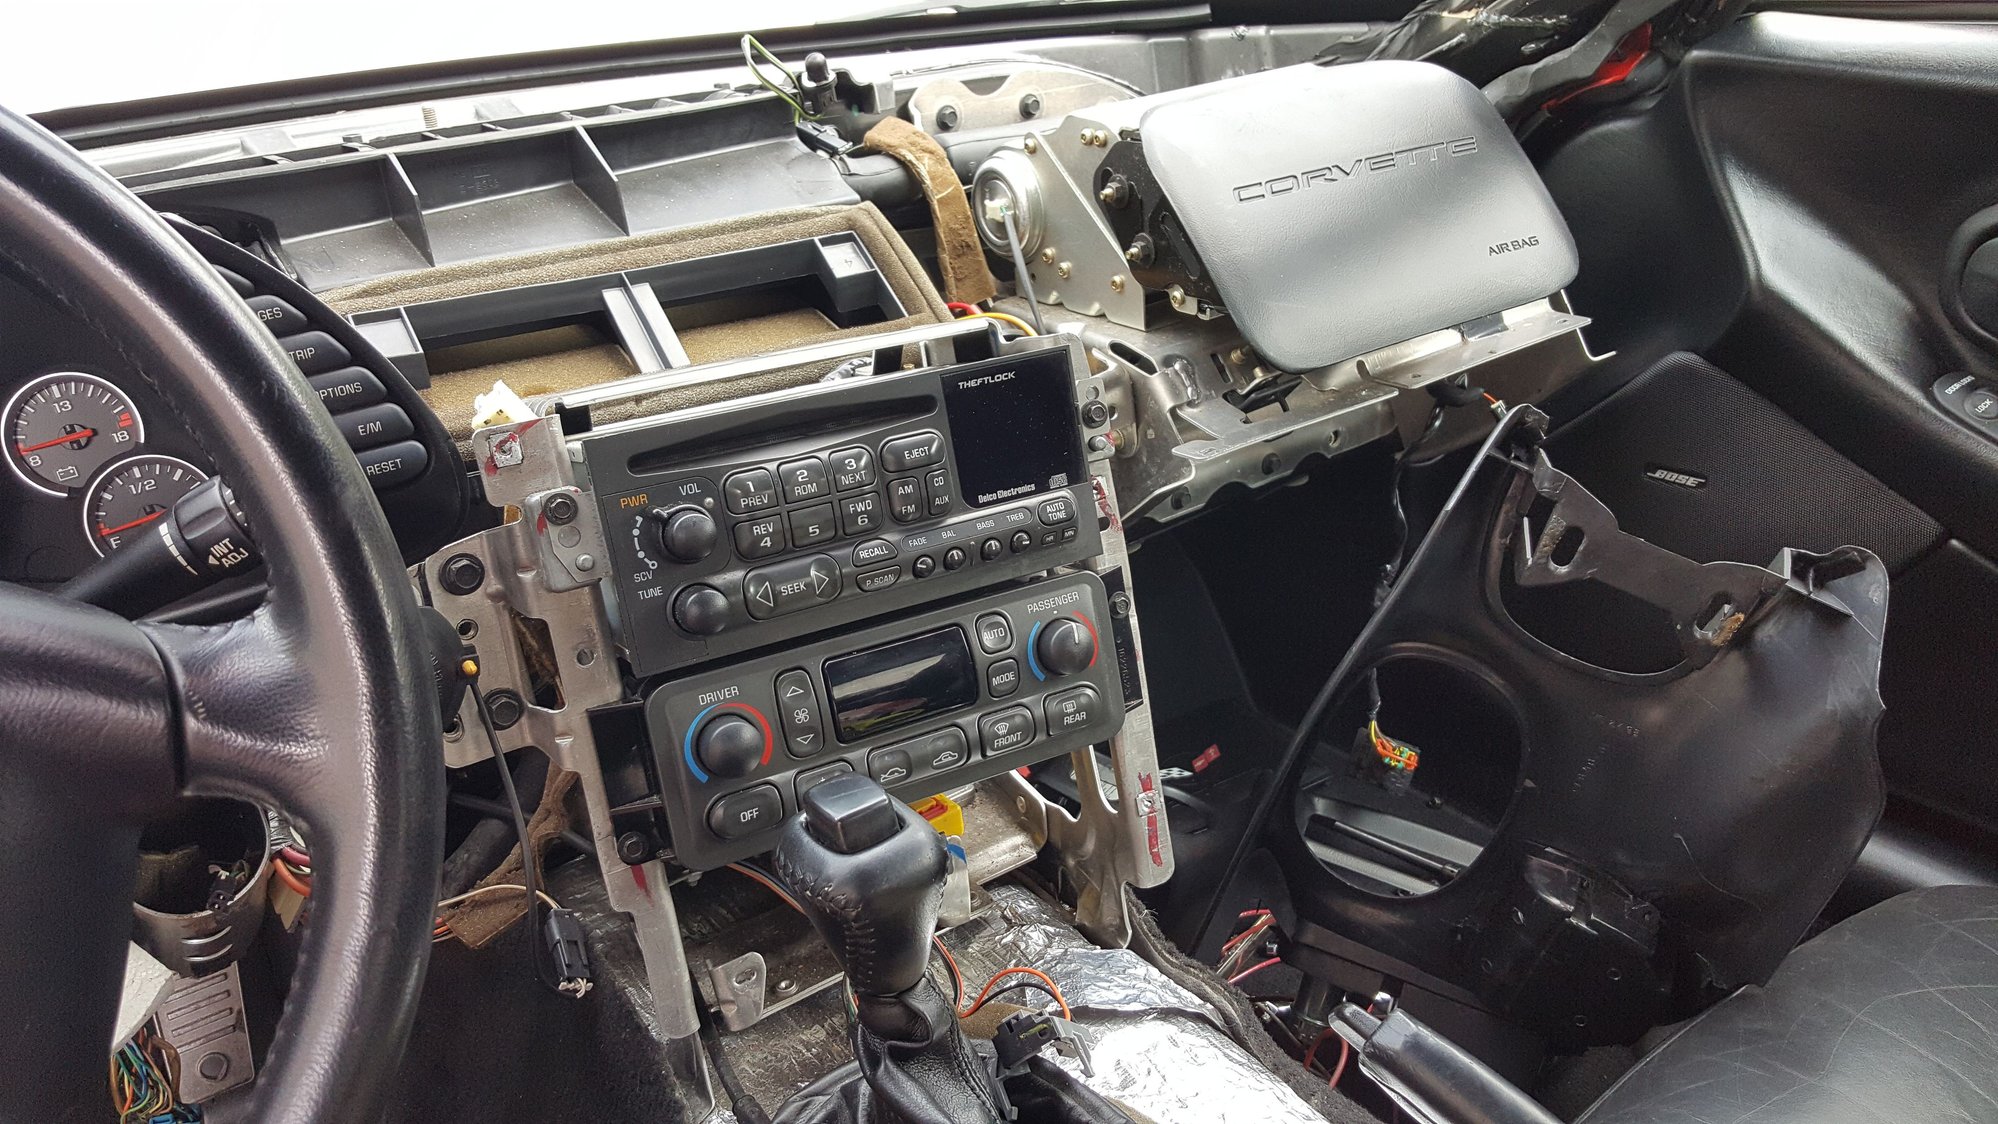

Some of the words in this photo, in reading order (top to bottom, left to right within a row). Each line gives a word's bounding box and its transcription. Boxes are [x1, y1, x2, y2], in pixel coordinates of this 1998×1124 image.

[1233, 136, 1478, 204] CORVETTE
[1488, 242, 1511, 257] AIR
[1512, 235, 1540, 251] BAG
[288, 347, 315, 361] TRIP
[958, 370, 1016, 390] THEFTLOCK
[53, 400, 72, 413] 13
[1975, 398, 1994, 413] LOCK
[358, 421, 382, 436] E/M
[111, 430, 130, 443] 18
[904, 446, 930, 460] EJECT
[29, 455, 42, 467] 8
[366, 458, 402, 476] RESET
[844, 458, 857, 470] 3
[796, 469, 808, 482] 2
[841, 470, 868, 485] NEXT
[933, 476, 945, 487] CD
[1647, 469, 1706, 488] BOSE
[129, 479, 157, 495] 1/2
[679, 482, 701, 496] VOL
[747, 481, 755, 492] 1
[794, 483, 818, 497] RDM
[897, 484, 914, 495] AM
[978, 491, 996, 504] Delco
[996, 483, 1036, 500] Electronics
[620, 493, 648, 509] PWR
[740, 494, 768, 508] PREV
[849, 500, 873, 514] FWD
[934, 496, 950, 507] AUX
[1046, 501, 1065, 513] AUTO
[901, 504, 917, 515] FM
[1048, 510, 1067, 521] TONE
[857, 514, 869, 526] 6
[1006, 512, 1026, 523] TREB
[752, 522, 774, 535] REV
[808, 524, 820, 537] 5
[976, 519, 996, 531] BASS
[760, 536, 772, 548] 4
[908, 536, 928, 548] FADE
[941, 530, 957, 540] BAL
[211, 538, 233, 558] INT
[858, 546, 889, 560] RECALL
[221, 547, 249, 568] ADJ
[633, 570, 654, 583] SCV
[637, 586, 664, 600] TUNE
[780, 580, 807, 596] SEEK
[1027, 591, 1080, 613] PASSENGER
[982, 627, 1006, 642] AUTO
[992, 671, 1016, 686] MODE
[699, 685, 740, 705] DRIVER
[1063, 711, 1087, 725] REAR
[994, 731, 1023, 748] FRONT
[740, 807, 760, 822] OFF
